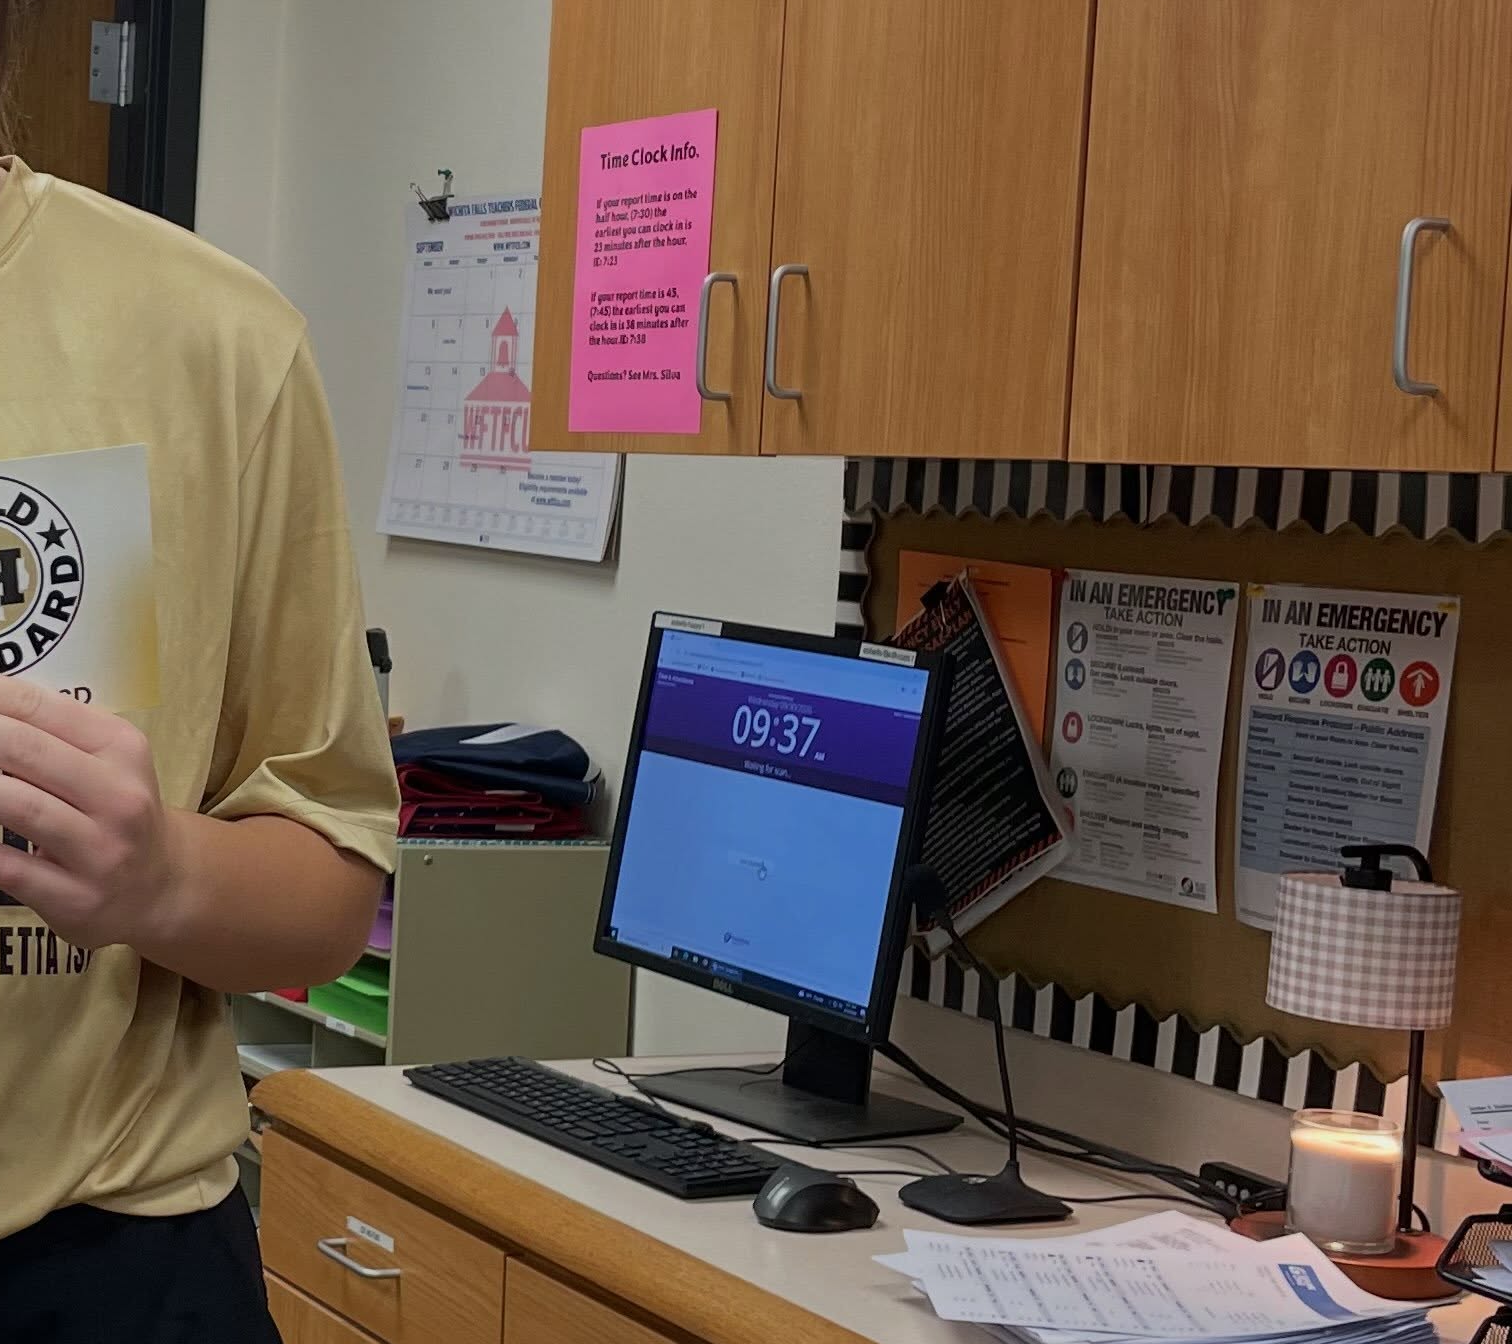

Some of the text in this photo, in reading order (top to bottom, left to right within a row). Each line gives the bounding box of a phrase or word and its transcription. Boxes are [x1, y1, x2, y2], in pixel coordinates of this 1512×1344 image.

[601, 141, 700, 170] Time Clock Info.
[604, 199, 619, 211] your
[621, 196, 643, 208] report
[645, 193, 662, 204] time
[673, 192, 683, 201] on
[685, 188, 697, 199] the
[631, 208, 653, 221] (7:30)
[654, 207, 666, 217] the
[595, 219, 692, 238] earliest you can clock in is
[594, 242, 602, 253] 23
[604, 240, 632, 252] minutes
[634, 238, 651, 249] after
[653, 237, 665, 247] the
[603, 256, 618, 267] 7:23
[598, 293, 614, 305] your
[616, 291, 638, 303] report
[639, 289, 656, 299] time
[658, 288, 665, 298] is
[612, 305, 623, 316] the
[625, 303, 653, 315] earliest
[655, 304, 669, 316] you
[671, 304, 686, 314] can
[589, 321, 609, 331] clock
[636, 318, 668, 329] minutes
[670, 317, 689, 329] after
[589, 335, 600, 346] the
[587, 369, 681, 383] Questions? See Mrs. Silva
[1070, 579, 1229, 617] IN AN EMERGENCY
[1104, 606, 1184, 628] TAKE ACTION
[1262, 599, 1449, 639] IN AN EMERGENCY
[1298, 633, 1392, 657] TAKE ACTION
[733, 705, 821, 758] 09:37
[1360, 723, 1385, 736] Public
[1387, 726, 1425, 741] Address
[65, 946, 93, 975] IS
